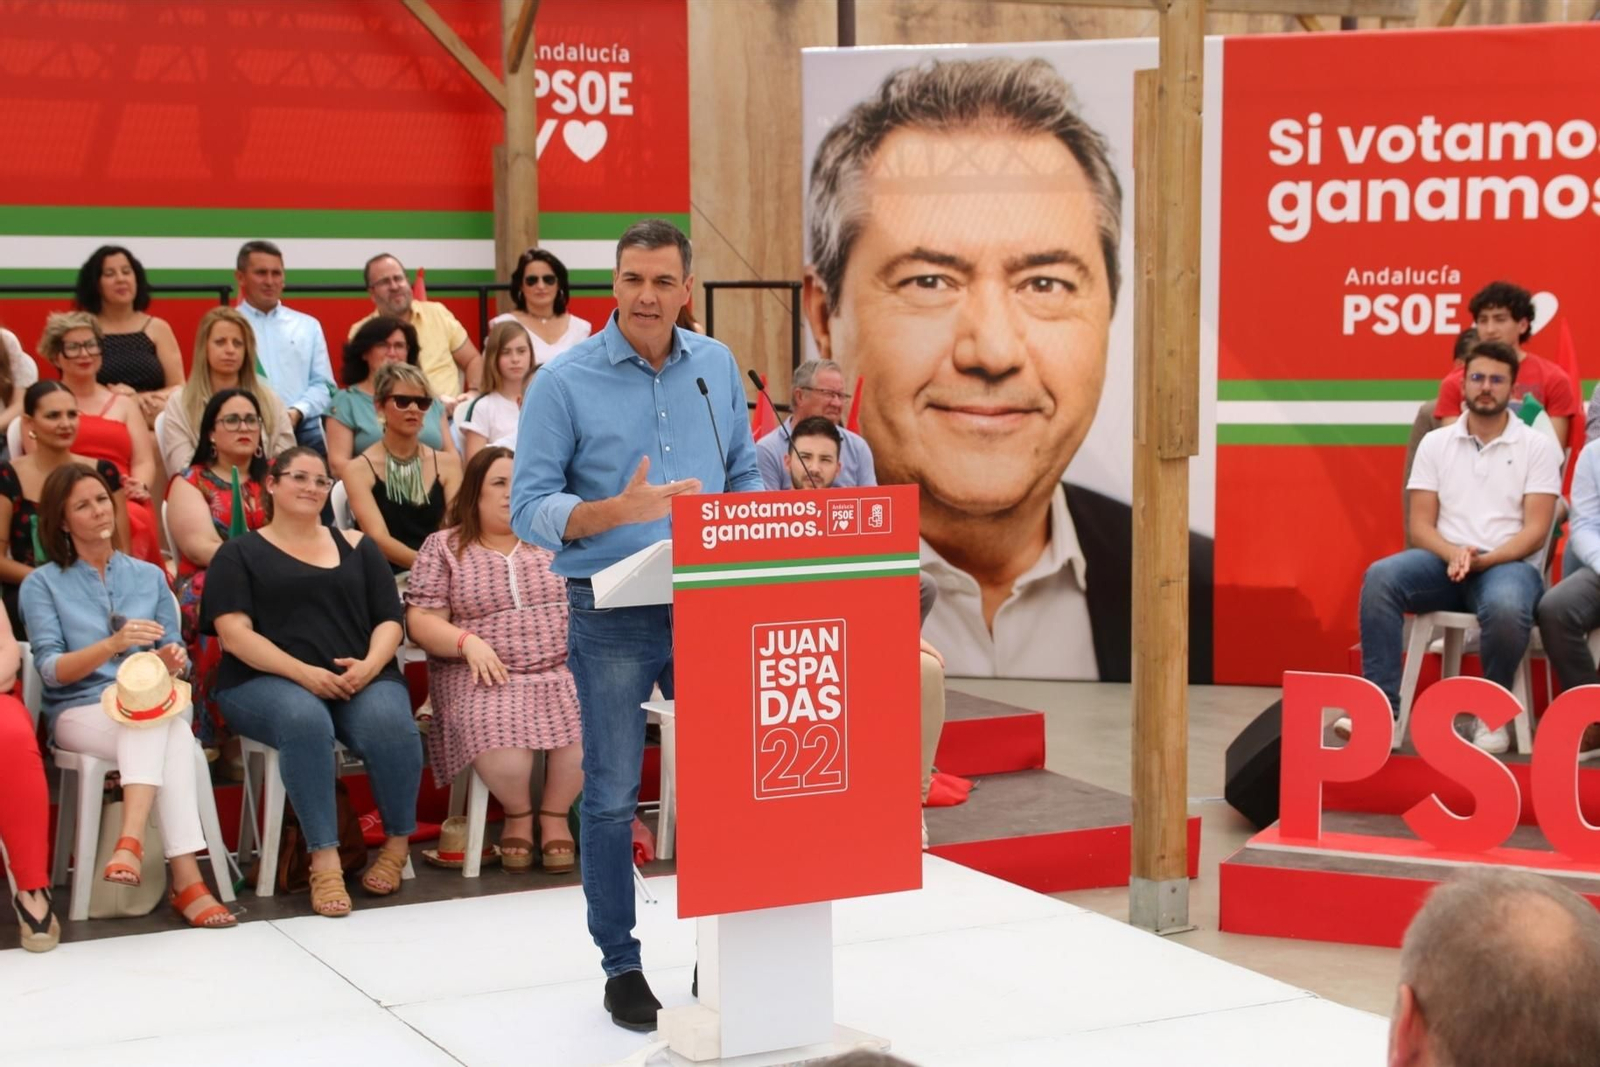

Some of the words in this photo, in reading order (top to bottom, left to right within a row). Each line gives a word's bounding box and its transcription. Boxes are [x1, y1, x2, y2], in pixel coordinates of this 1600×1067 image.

[534, 43, 630, 63] ndalucía
[1268, 112, 1323, 166] Si
[1337, 115, 1600, 164] votamo
[1344, 265, 1461, 286] Andalucía
[1342, 293, 1462, 336] PSOE
[702, 500, 720, 520] Si
[723, 501, 822, 520] votamos,
[832, 510, 855, 520] PSOE
[701, 520, 823, 550] ganamos.
[759, 626, 840, 657] JUAN
[759, 655, 840, 689] ESPA
[760, 685, 842, 726] DAS
[761, 723, 842, 792] 22
